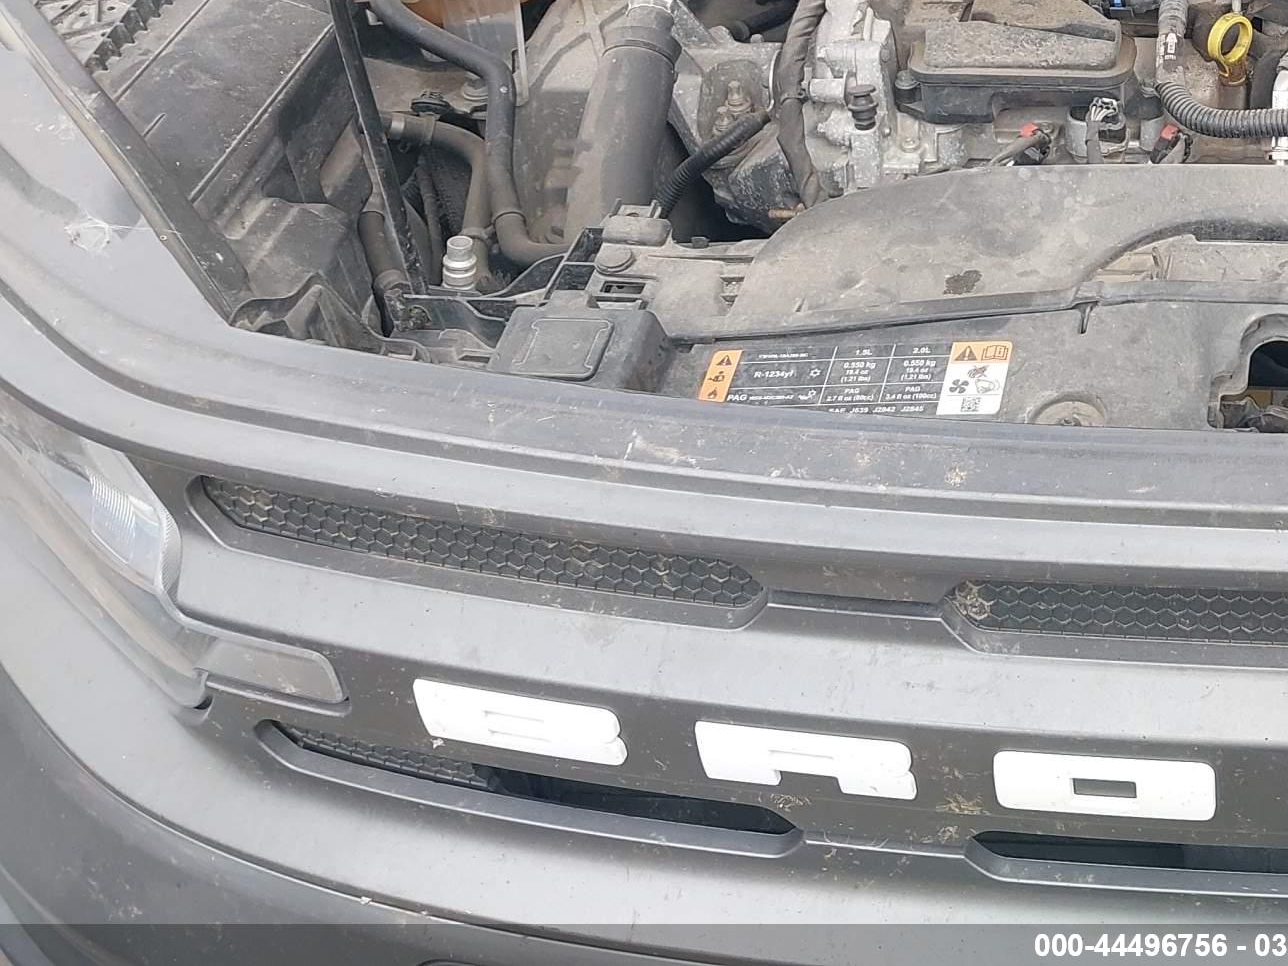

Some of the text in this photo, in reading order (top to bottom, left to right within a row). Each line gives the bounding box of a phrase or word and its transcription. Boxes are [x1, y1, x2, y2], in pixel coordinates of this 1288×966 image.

[912, 346, 931, 354] 2.0L
[865, 361, 877, 370] kg
[925, 359, 936, 368] kg
[753, 369, 795, 379] R-1234yf
[726, 393, 748, 402] PAG
